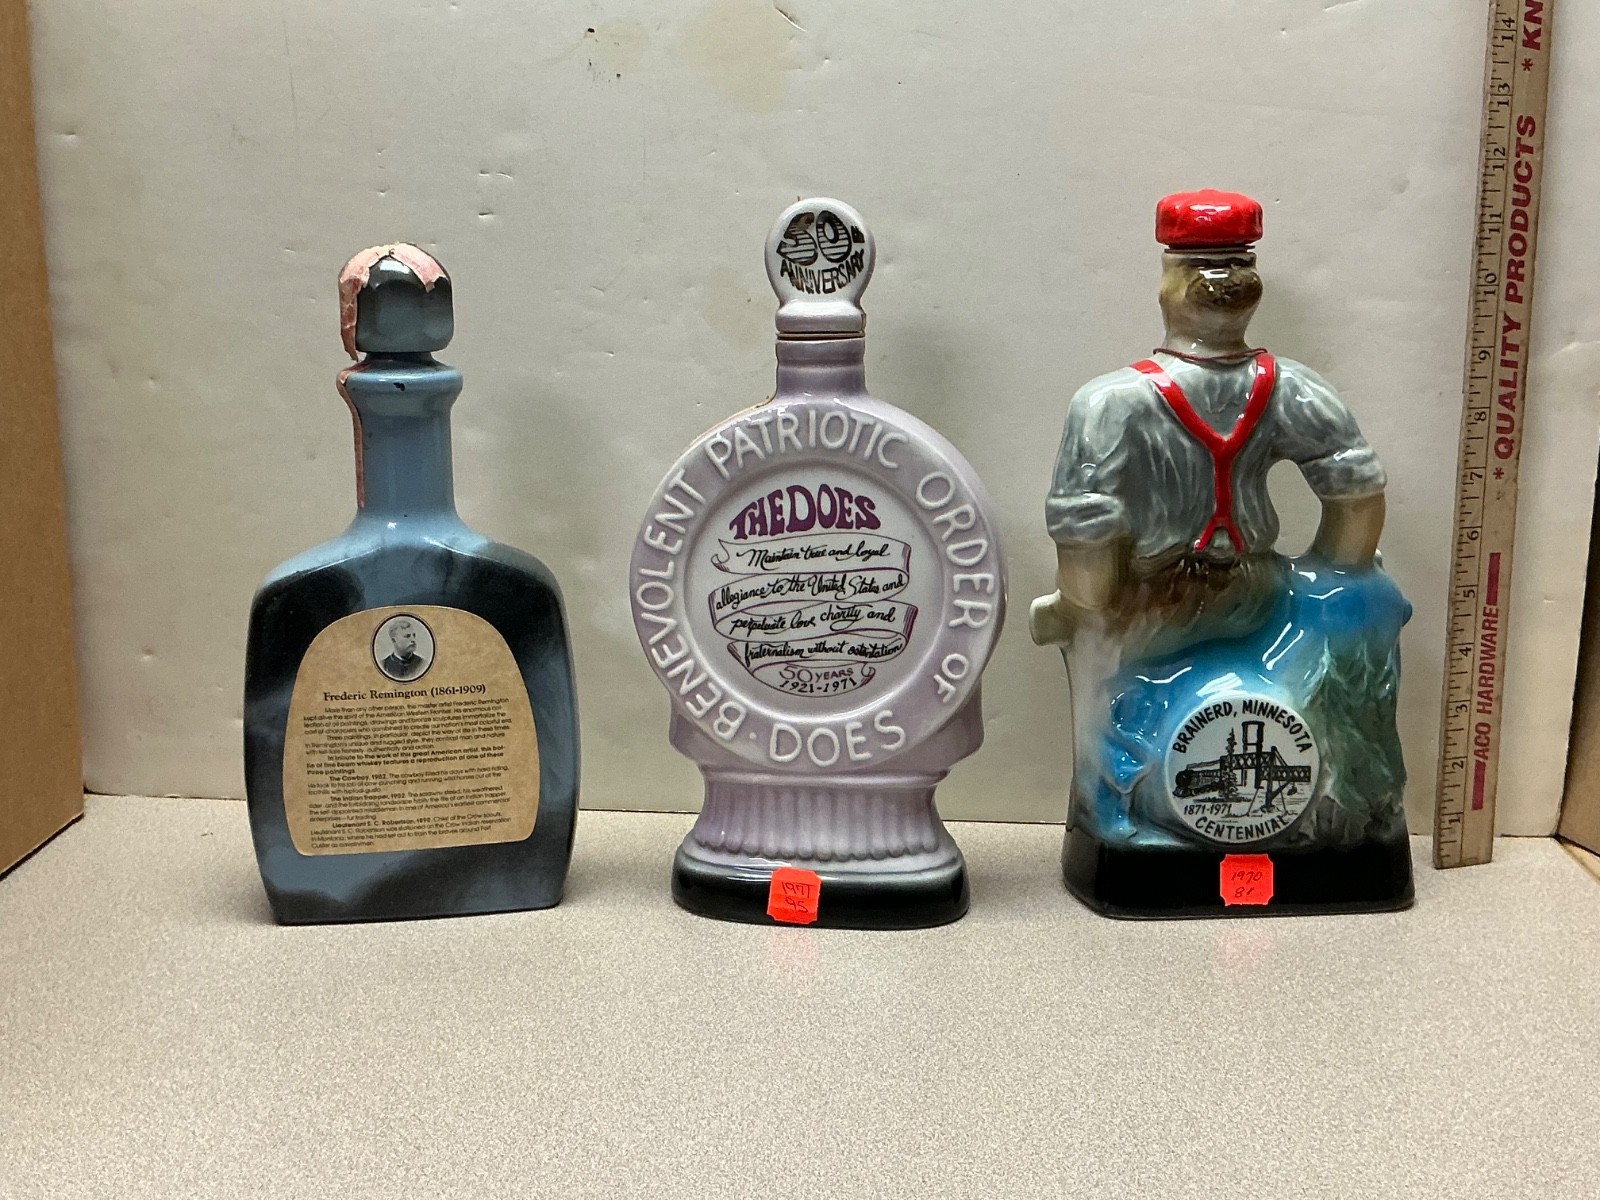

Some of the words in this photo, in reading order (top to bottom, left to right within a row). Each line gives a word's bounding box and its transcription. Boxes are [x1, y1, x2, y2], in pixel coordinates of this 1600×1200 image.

[1501, 17, 1515, 41] 14
[1497, 83, 1510, 106] 13
[1492, 147, 1506, 170] 12
[1504, 115, 1537, 304] PRODUCTS
[1488, 212, 1502, 234] 11
[1483, 272, 1497, 297] 10
[1479, 350, 1491, 361] 9
[1494, 311, 1522, 460] QUALITY
[1474, 411, 1487, 422] 8
[704, 410, 909, 481] PATRIOTIC
[1469, 471, 1483, 481] 7
[729, 489, 785, 540] THE
[786, 484, 881, 532] DOES
[1467, 529, 1479, 541] 6
[736, 548, 801, 570] Maintain
[801, 545, 828, 560] true
[828, 544, 853, 561] and
[856, 540, 891, 562] loyal
[916, 471, 994, 630] ORDER
[716, 587, 767, 610] allegiance
[786, 575, 805, 593] the
[808, 574, 847, 600] United
[849, 575, 880, 600] States
[882, 574, 905, 592] and
[1463, 588, 1476, 600] 5
[636, 468, 748, 741] BENEVOLENT
[820, 604, 866, 631] charity
[867, 607, 896, 623] and
[807, 641, 846, 656] without
[1459, 646, 1472, 657] 4
[1477, 605, 1499, 714] HARDWARE
[779, 666, 812, 683] 50
[815, 668, 854, 682] YEARS
[779, 677, 858, 693] 1921-1971
[934, 652, 969, 703] OF
[323, 691, 366, 702] Frederic
[370, 688, 427, 702] Remington
[430, 684, 486, 698] (1861-1909)
[1455, 703, 1467, 713] 3
[769, 709, 907, 767] DOES
[1172, 701, 1237, 754] BRAINERD,
[1242, 699, 1313, 753] MINNESOTA
[1475, 722, 1491, 761] ACO
[1452, 759, 1464, 770] 2
[1184, 803, 1232, 816] 1871-1971
[1448, 814, 1460, 826] 1
[1195, 814, 1290, 840] CENTENNIAL
